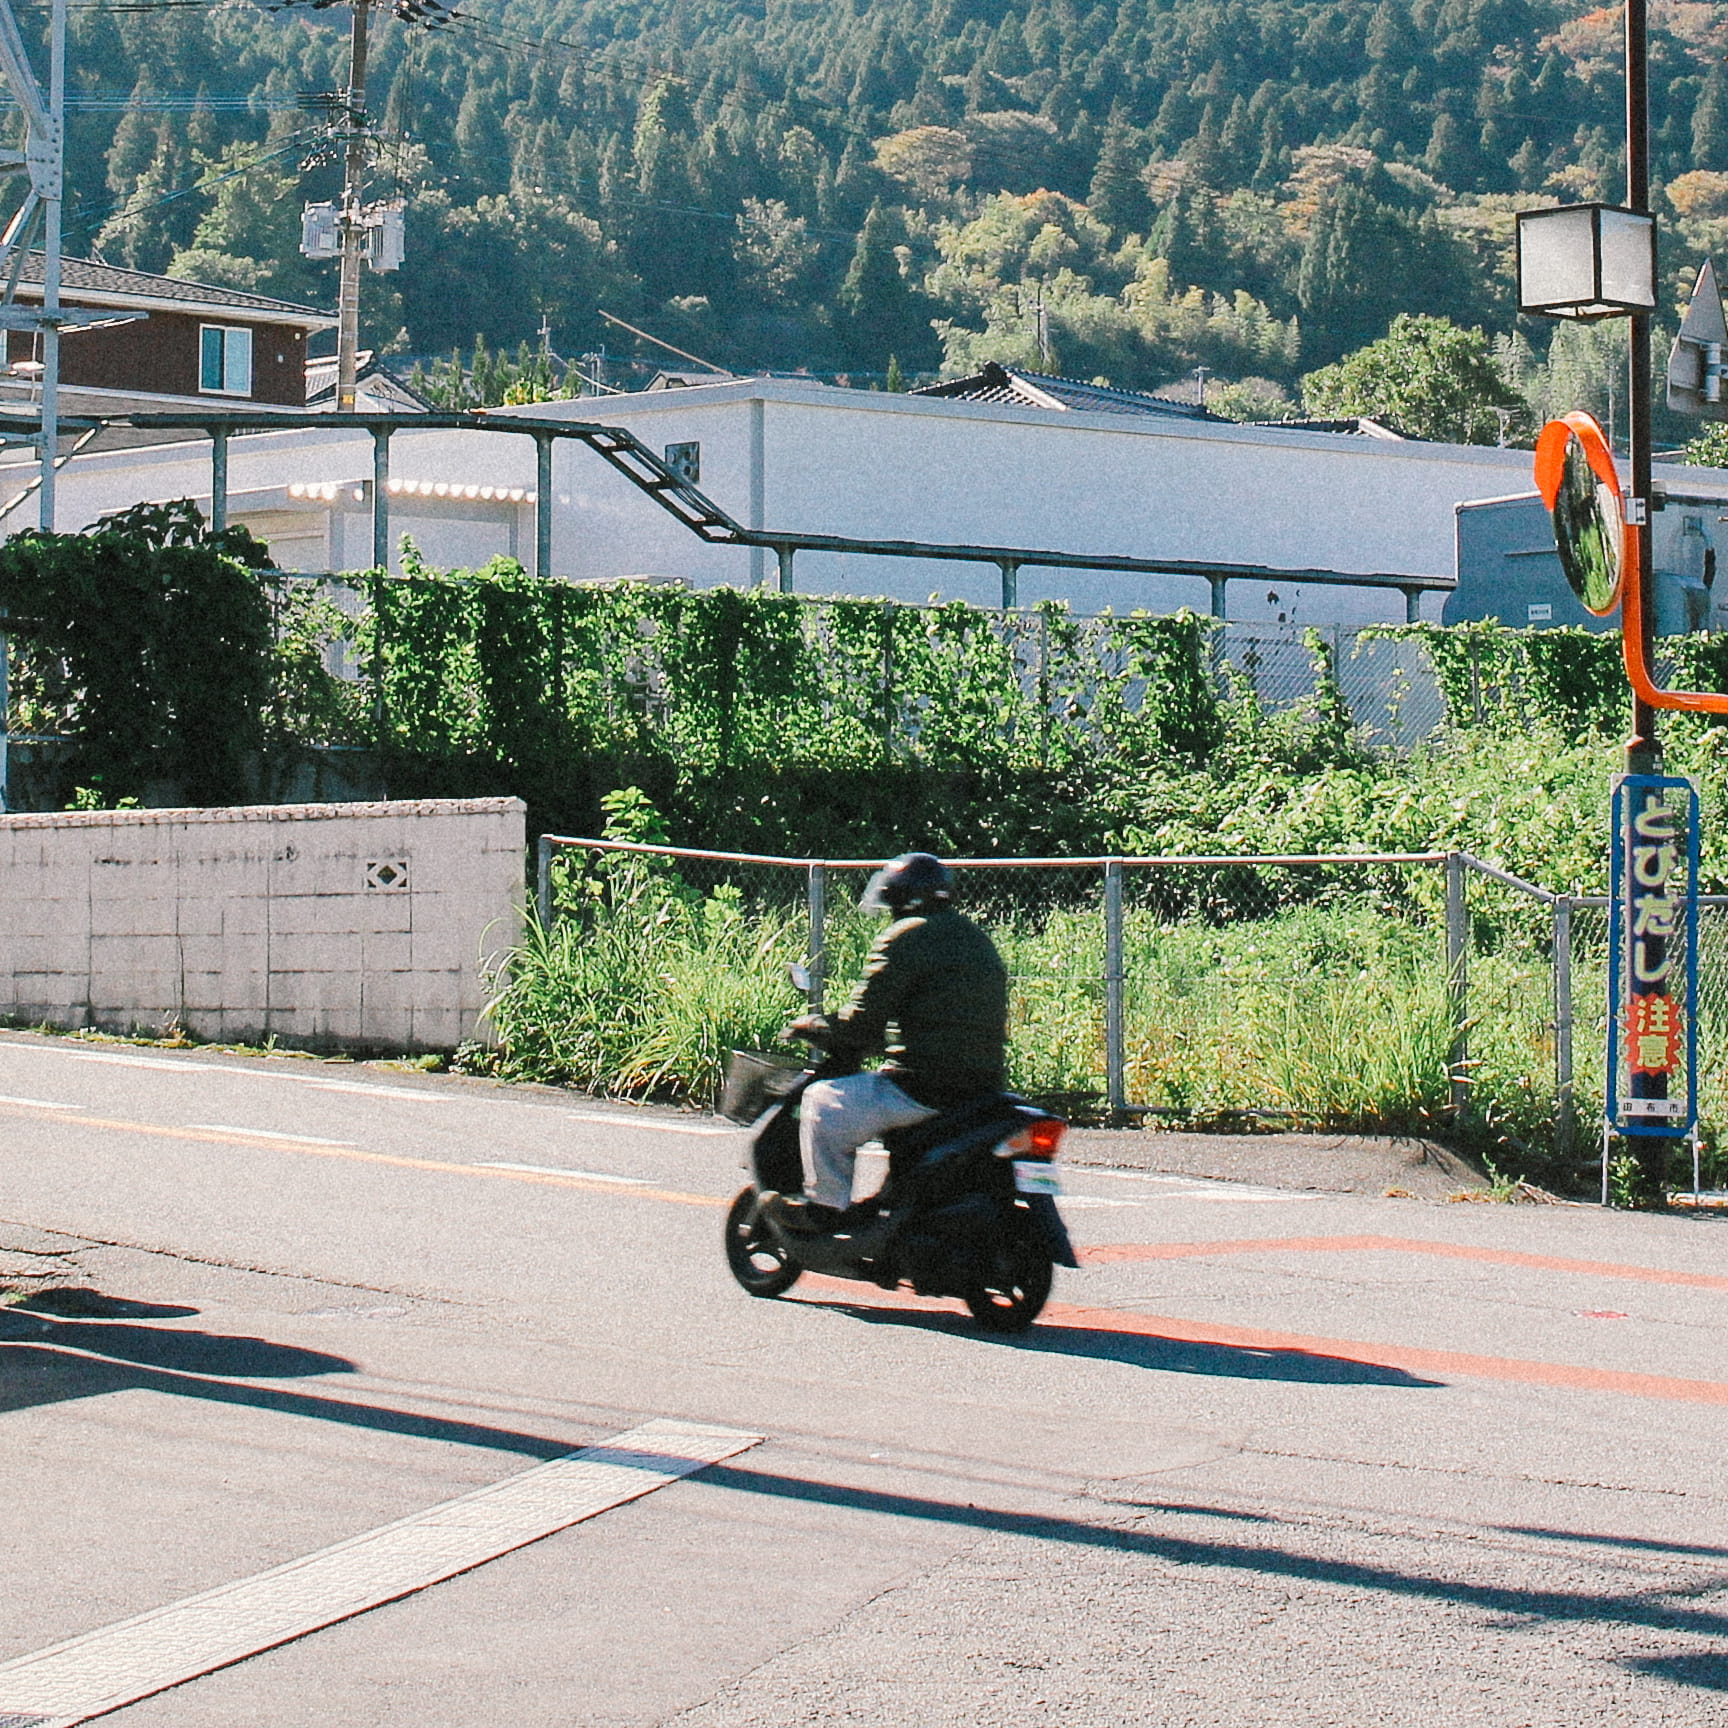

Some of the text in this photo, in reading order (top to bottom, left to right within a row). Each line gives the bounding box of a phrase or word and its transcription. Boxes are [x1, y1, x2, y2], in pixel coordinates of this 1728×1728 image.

[1633, 795, 1679, 983] とびだし
[1636, 998, 1670, 1068] 注意
